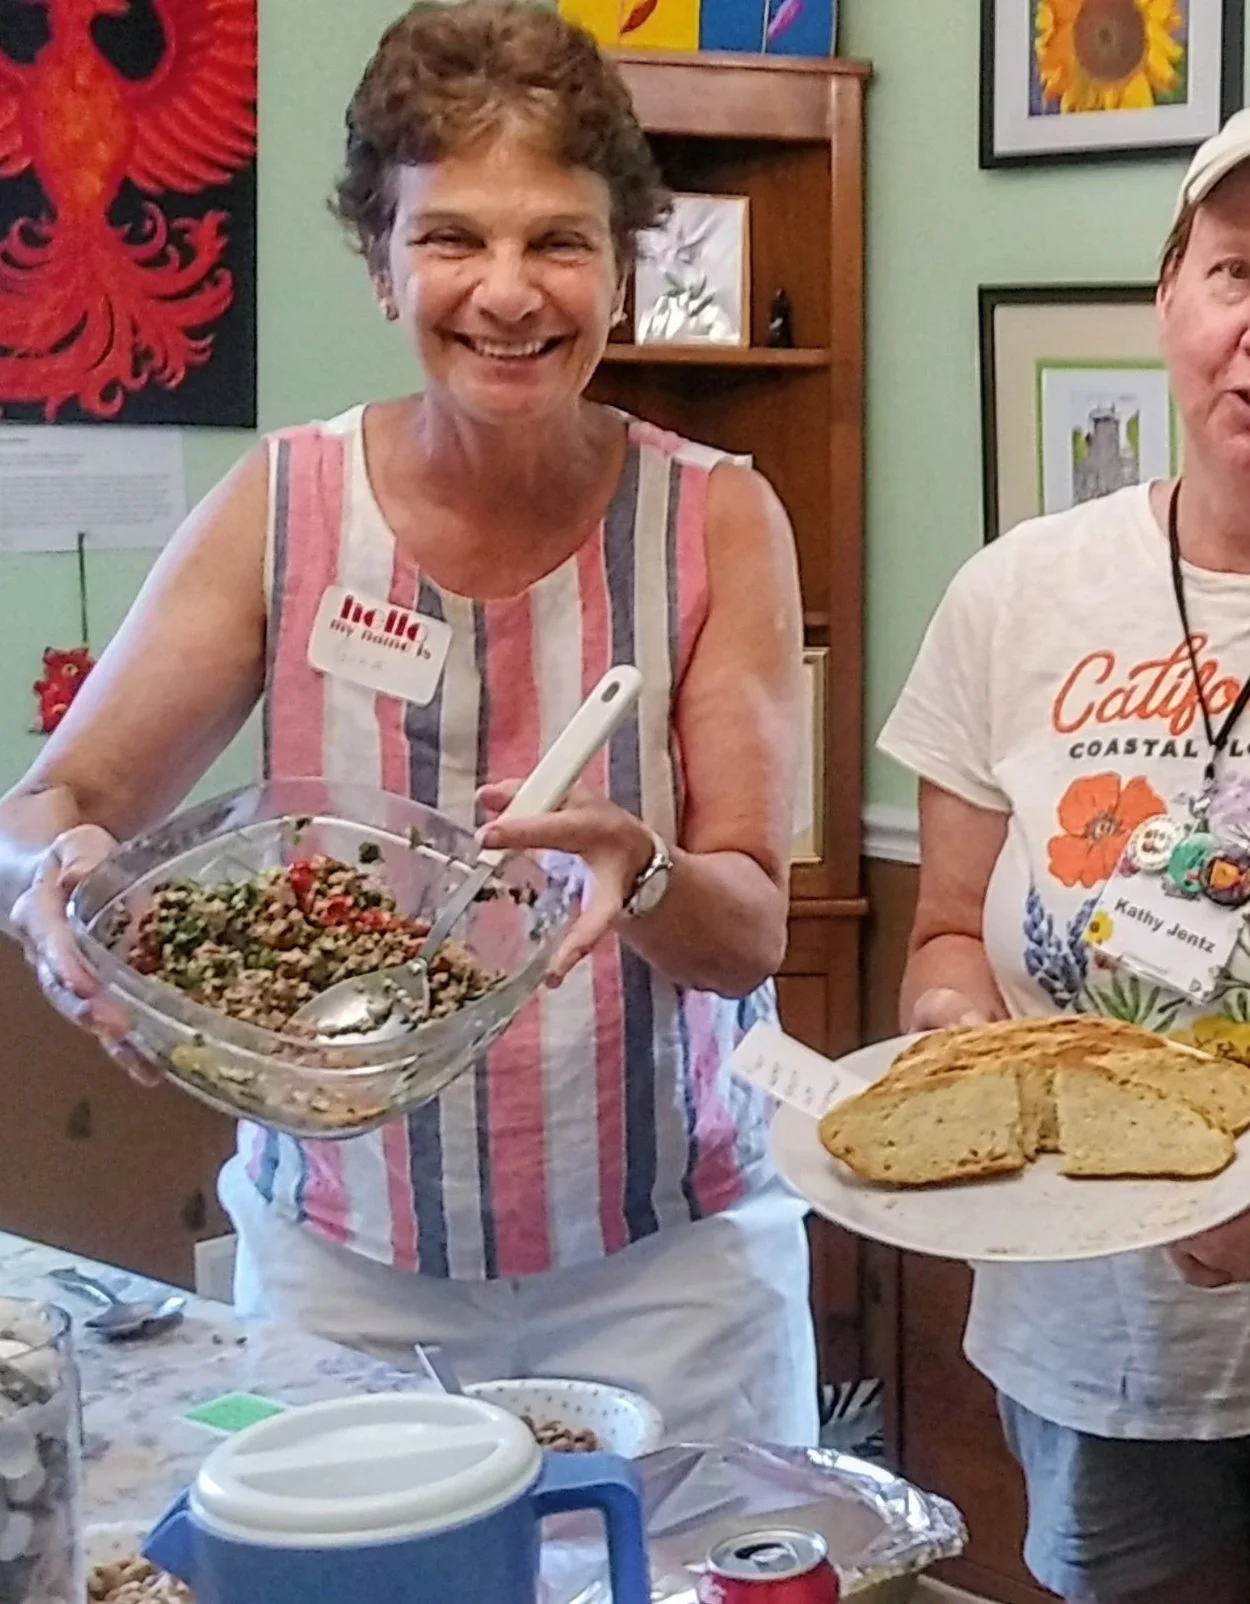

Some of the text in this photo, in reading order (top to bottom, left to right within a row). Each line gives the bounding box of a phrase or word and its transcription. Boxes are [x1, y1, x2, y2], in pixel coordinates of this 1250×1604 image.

[330, 619, 354, 637] my
[361, 629, 410, 651] name
[340, 594, 429, 641] hello
[1069, 738, 1198, 758] COASTAL
[1114, 898, 1216, 953] Kathy Jentz
